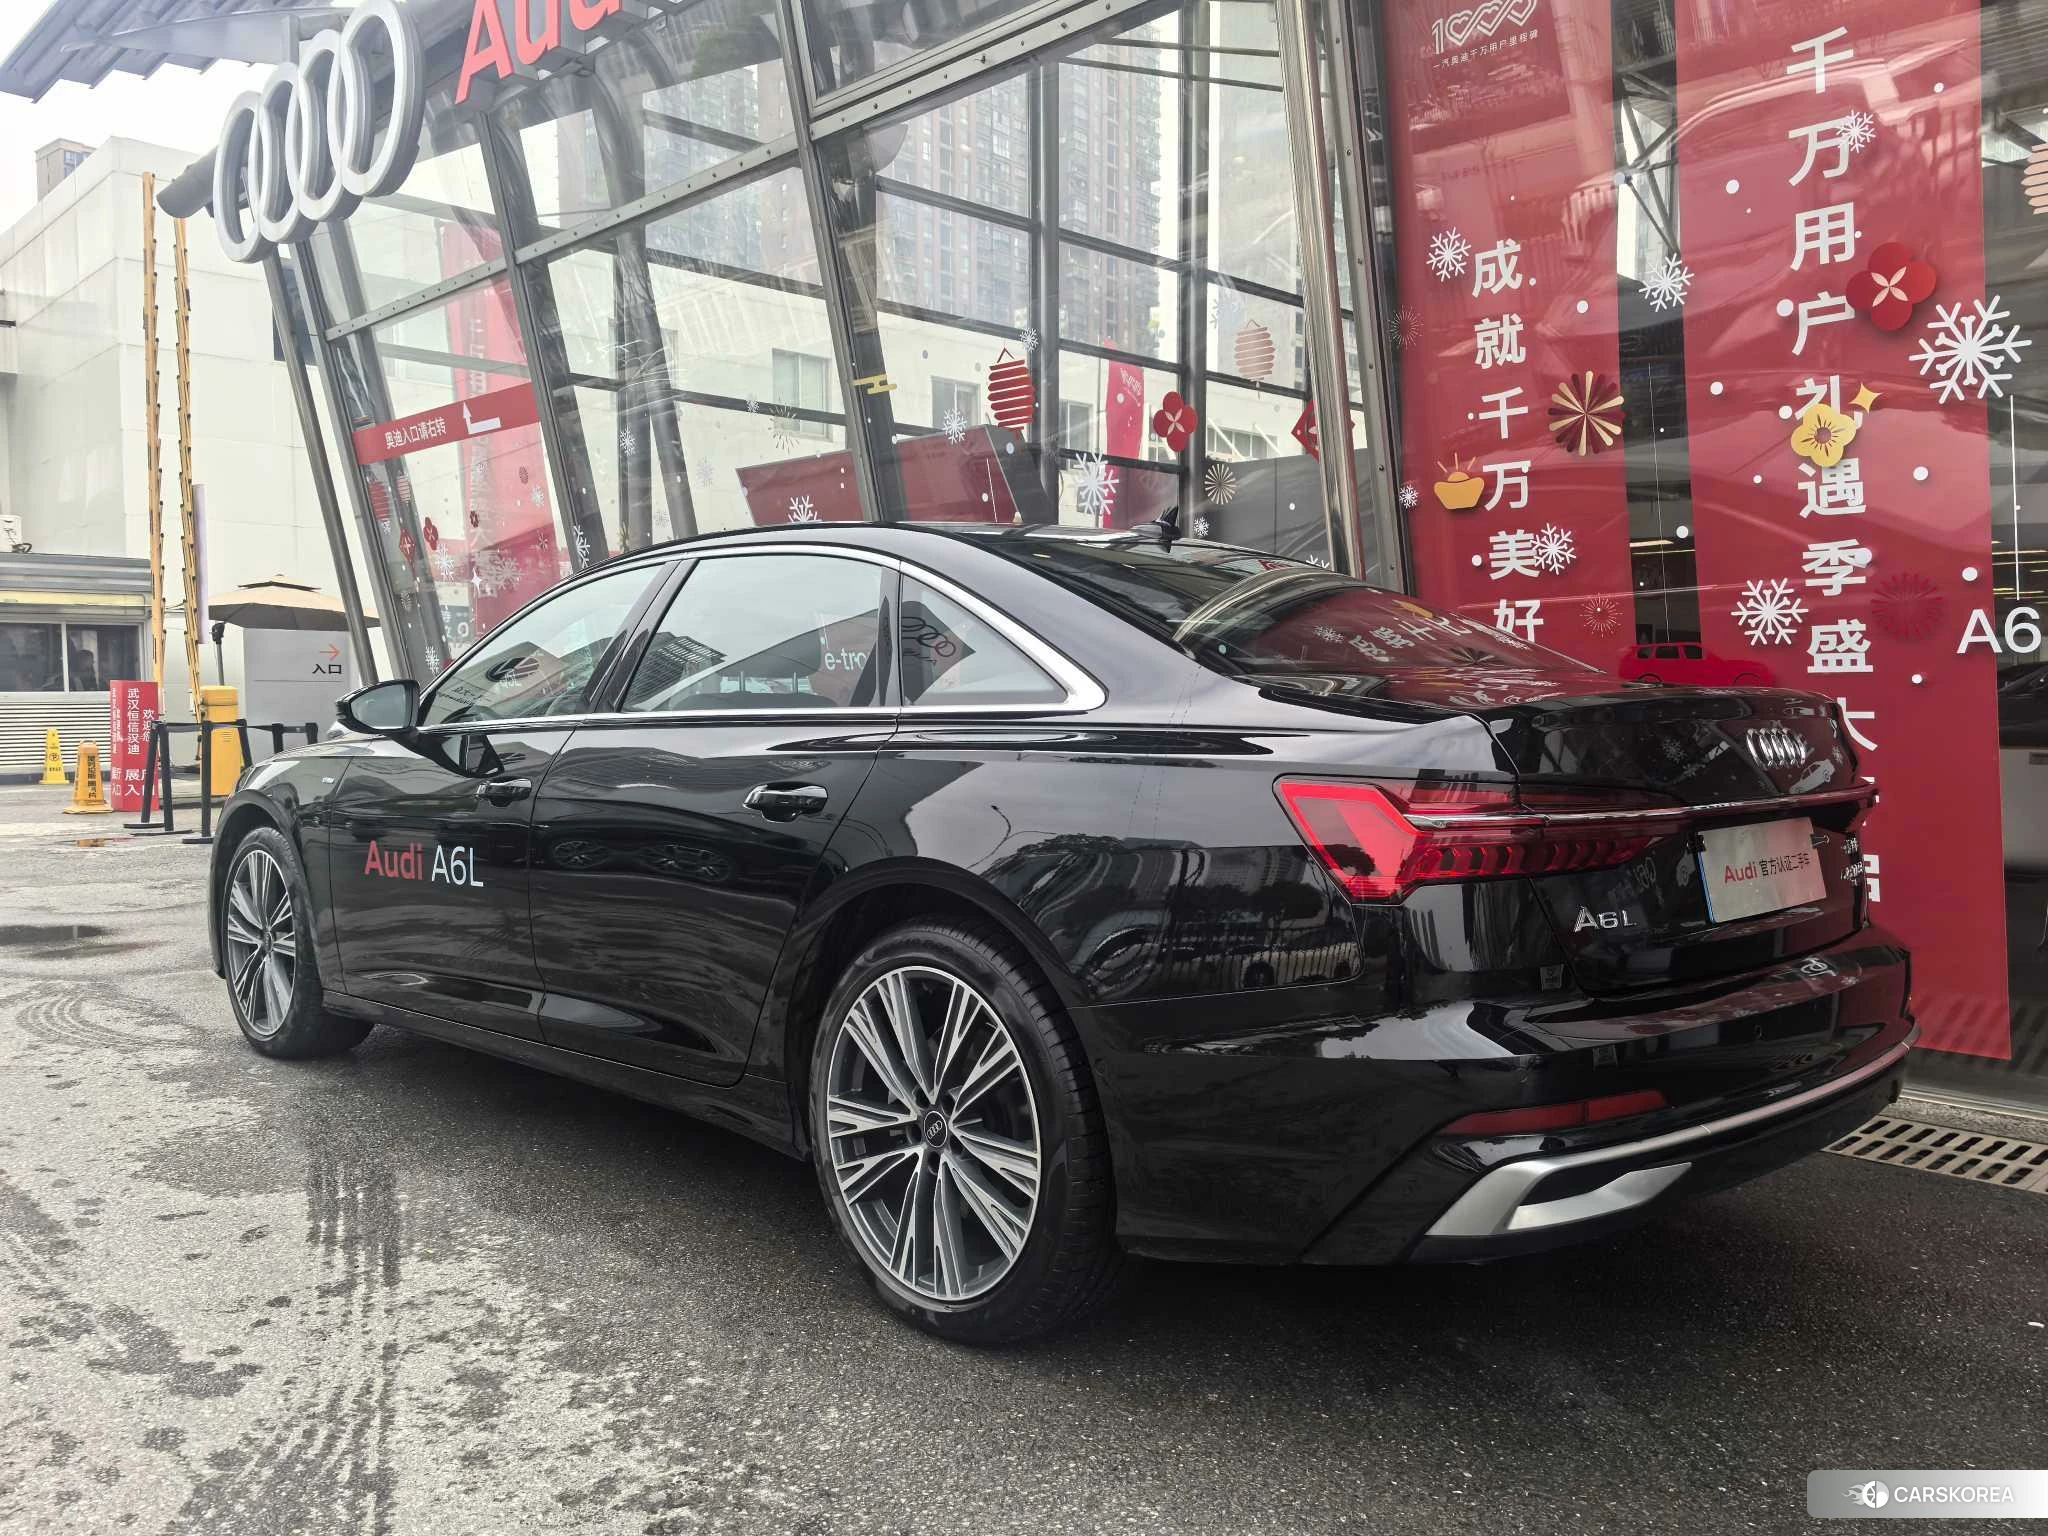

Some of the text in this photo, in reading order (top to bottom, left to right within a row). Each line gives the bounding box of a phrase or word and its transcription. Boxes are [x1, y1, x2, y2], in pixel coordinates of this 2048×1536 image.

[384, 416, 447, 450] 奥迪入口请右转
[1472, 237, 1544, 643] 成就千万美好
[1956, 606, 2042, 654] A6
[312, 663, 342, 675] 入口
[364, 839, 484, 887] Audi A6L
[1724, 861, 1758, 884] Audi
[1573, 905, 1638, 933] A6L
